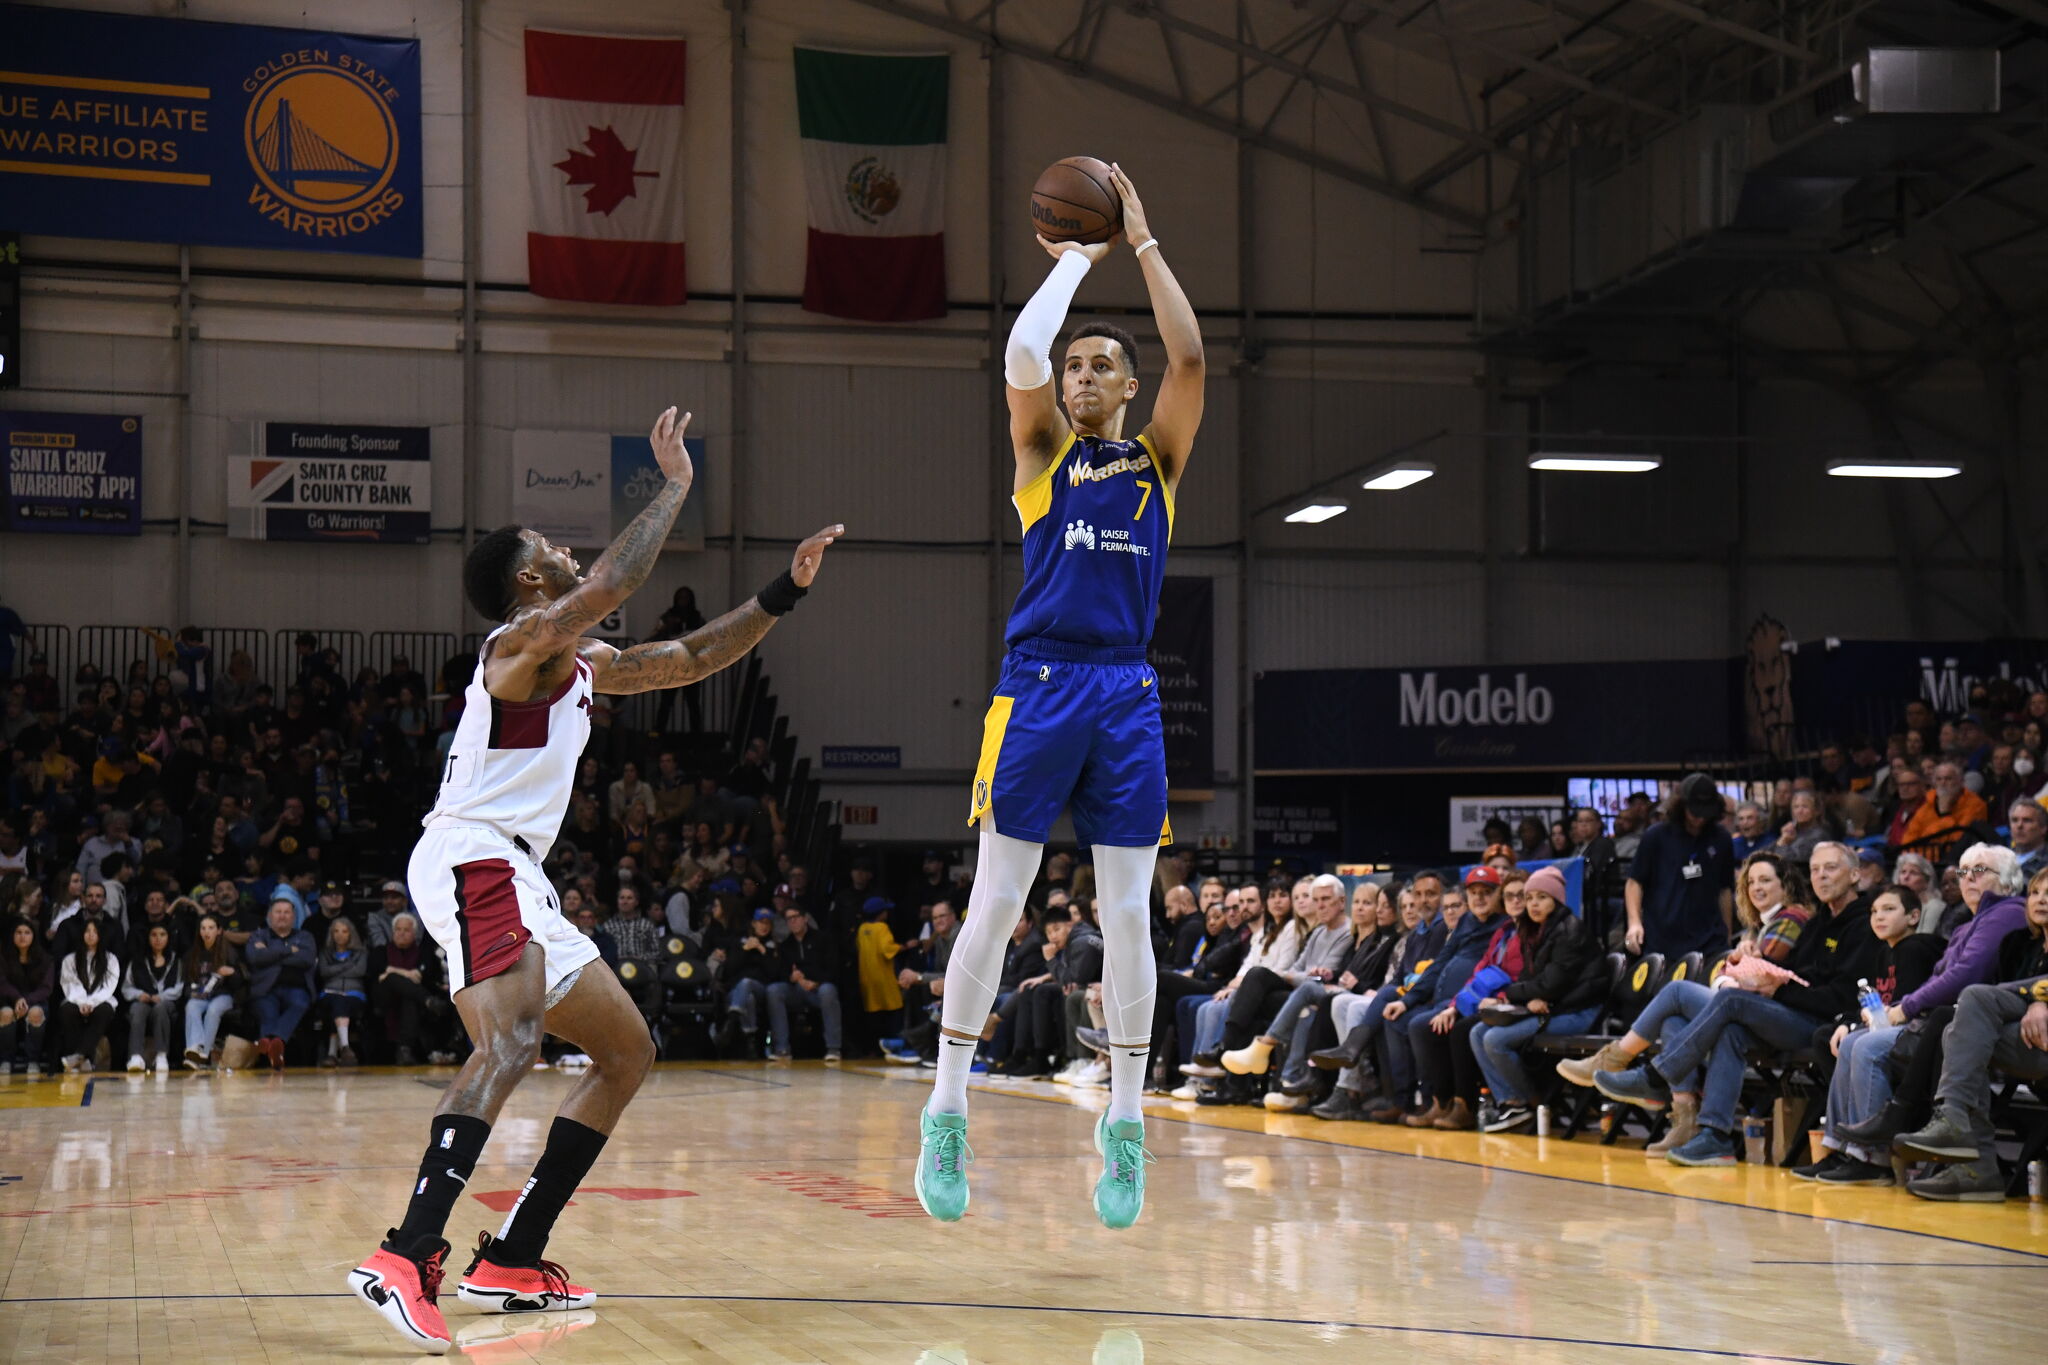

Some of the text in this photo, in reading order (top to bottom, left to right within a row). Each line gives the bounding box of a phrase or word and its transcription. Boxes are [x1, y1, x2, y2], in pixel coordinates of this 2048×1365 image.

[242, 48, 400, 103] GOLDEN STATE
[49, 98, 209, 132] AFFILIATE
[0, 129, 178, 163] WARRIORS
[247, 183, 405, 237] WARRIORS
[1031, 199, 1083, 230] Wilson
[291, 432, 401, 453] Founding Sponsor
[10, 447, 107, 474] SANTA CRUZ
[299, 462, 387, 481] SANTA CRUZ
[10, 472, 136, 500] WARRIORS APP!
[300, 483, 412, 504] COUNTY BANK
[1133, 479, 1152, 521] 7
[307, 513, 386, 530] Go Warriors!
[1101, 529, 1129, 540] KAISER
[1399, 672, 1553, 727] Modelo
[824, 751, 898, 763] RESTROOMS
